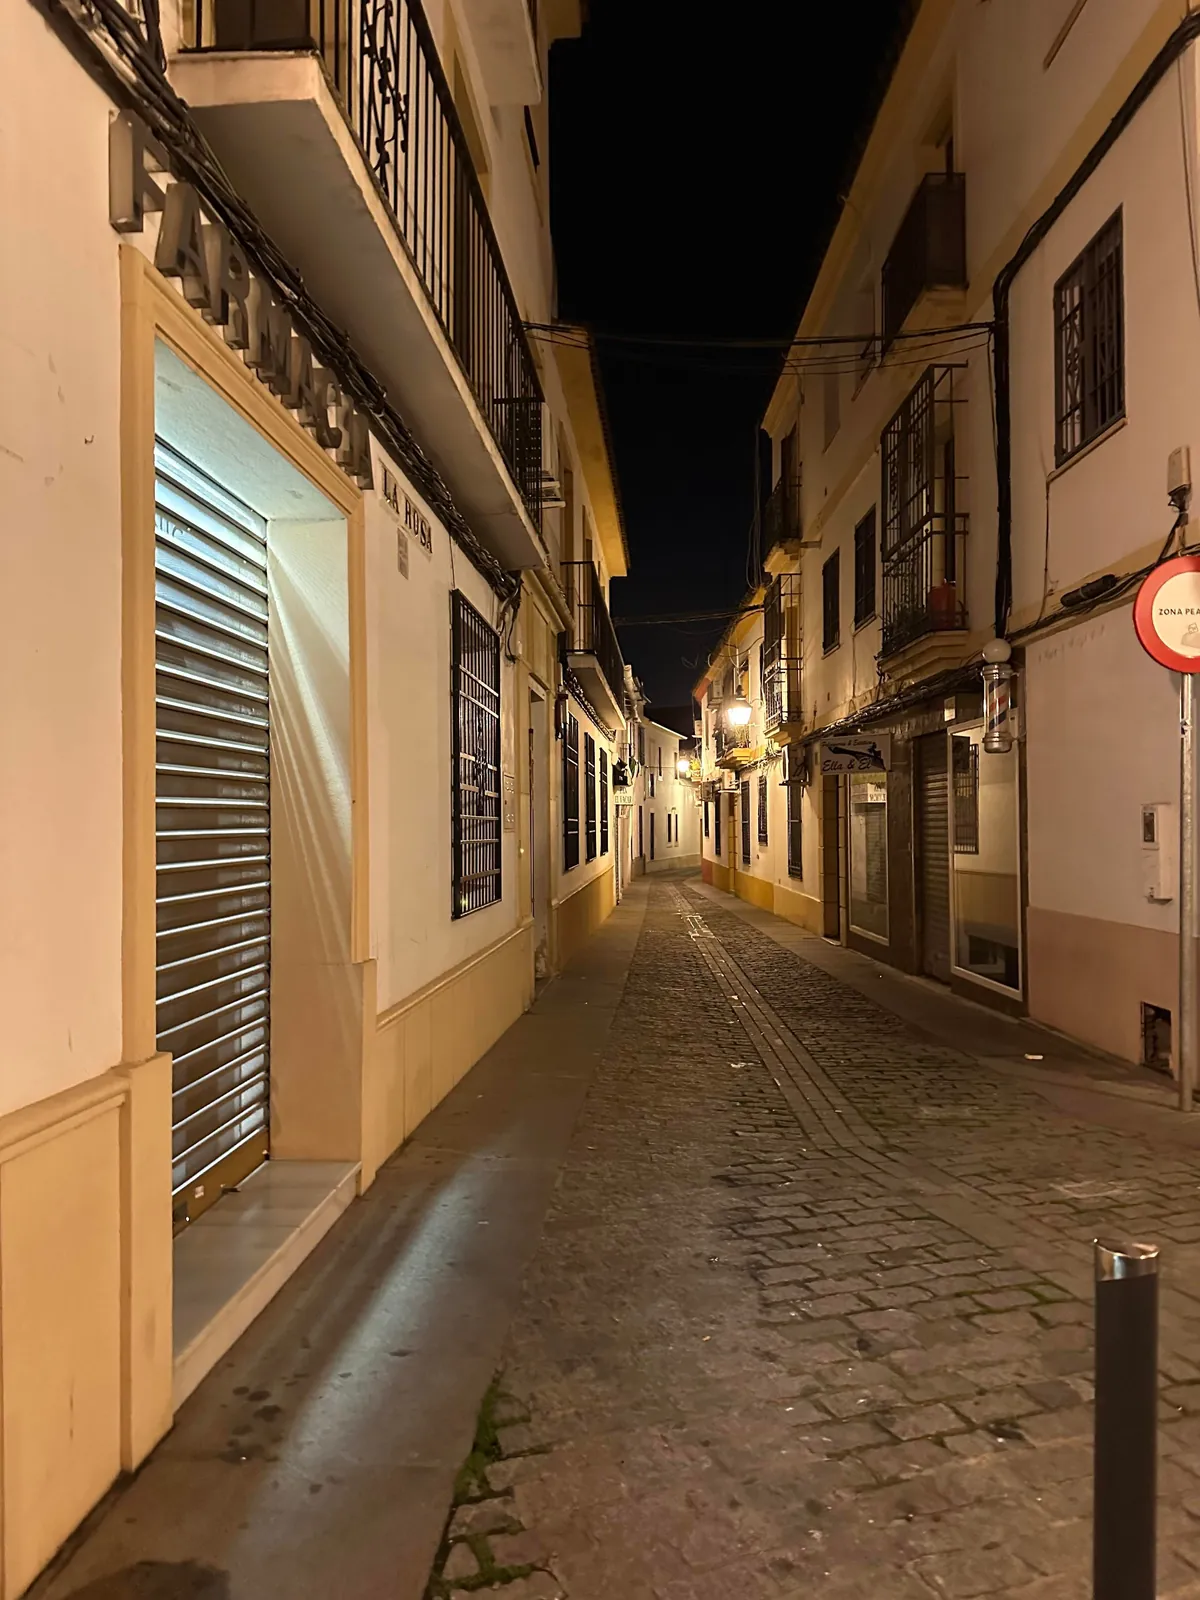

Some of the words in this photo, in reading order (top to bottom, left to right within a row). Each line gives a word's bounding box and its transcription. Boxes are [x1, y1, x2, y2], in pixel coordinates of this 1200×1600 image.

[110, 108, 374, 490] FARMACIA
[381, 464, 399, 515] LA
[405, 495, 433, 554] ROSA
[1158, 608, 1183, 616] ZONA
[822, 759, 843, 772] Ella
[847, 759, 855, 769] &
[858, 757, 871, 770] El
